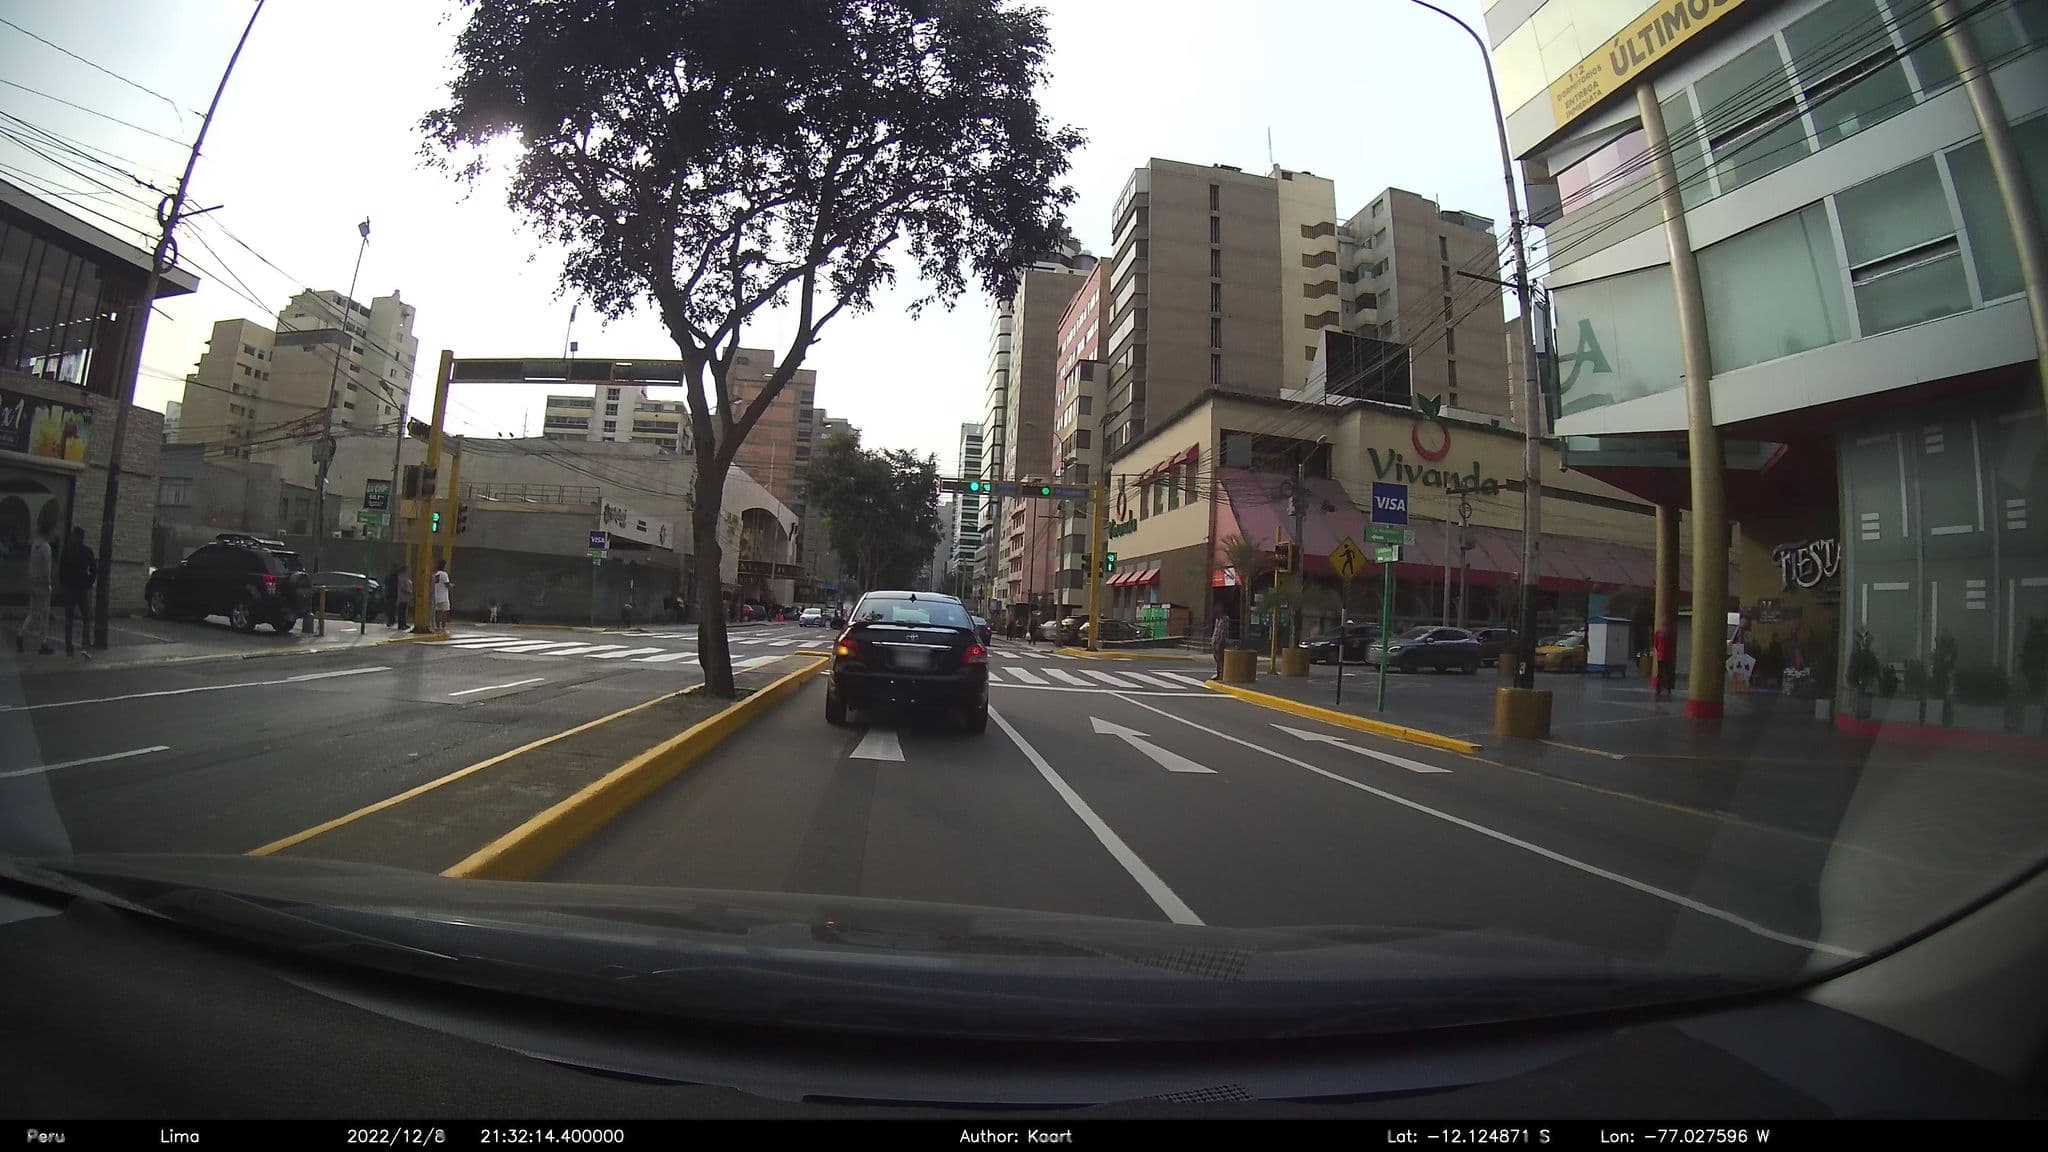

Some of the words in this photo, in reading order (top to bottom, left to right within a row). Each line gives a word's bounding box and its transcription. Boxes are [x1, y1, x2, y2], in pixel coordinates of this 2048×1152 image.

[1557, 64, 1602, 102] DORMITORIOS
[1565, 81, 1599, 109] ENTREGA
[1367, 447, 1498, 495] Vivanda
[1374, 496, 1406, 511] VISA
